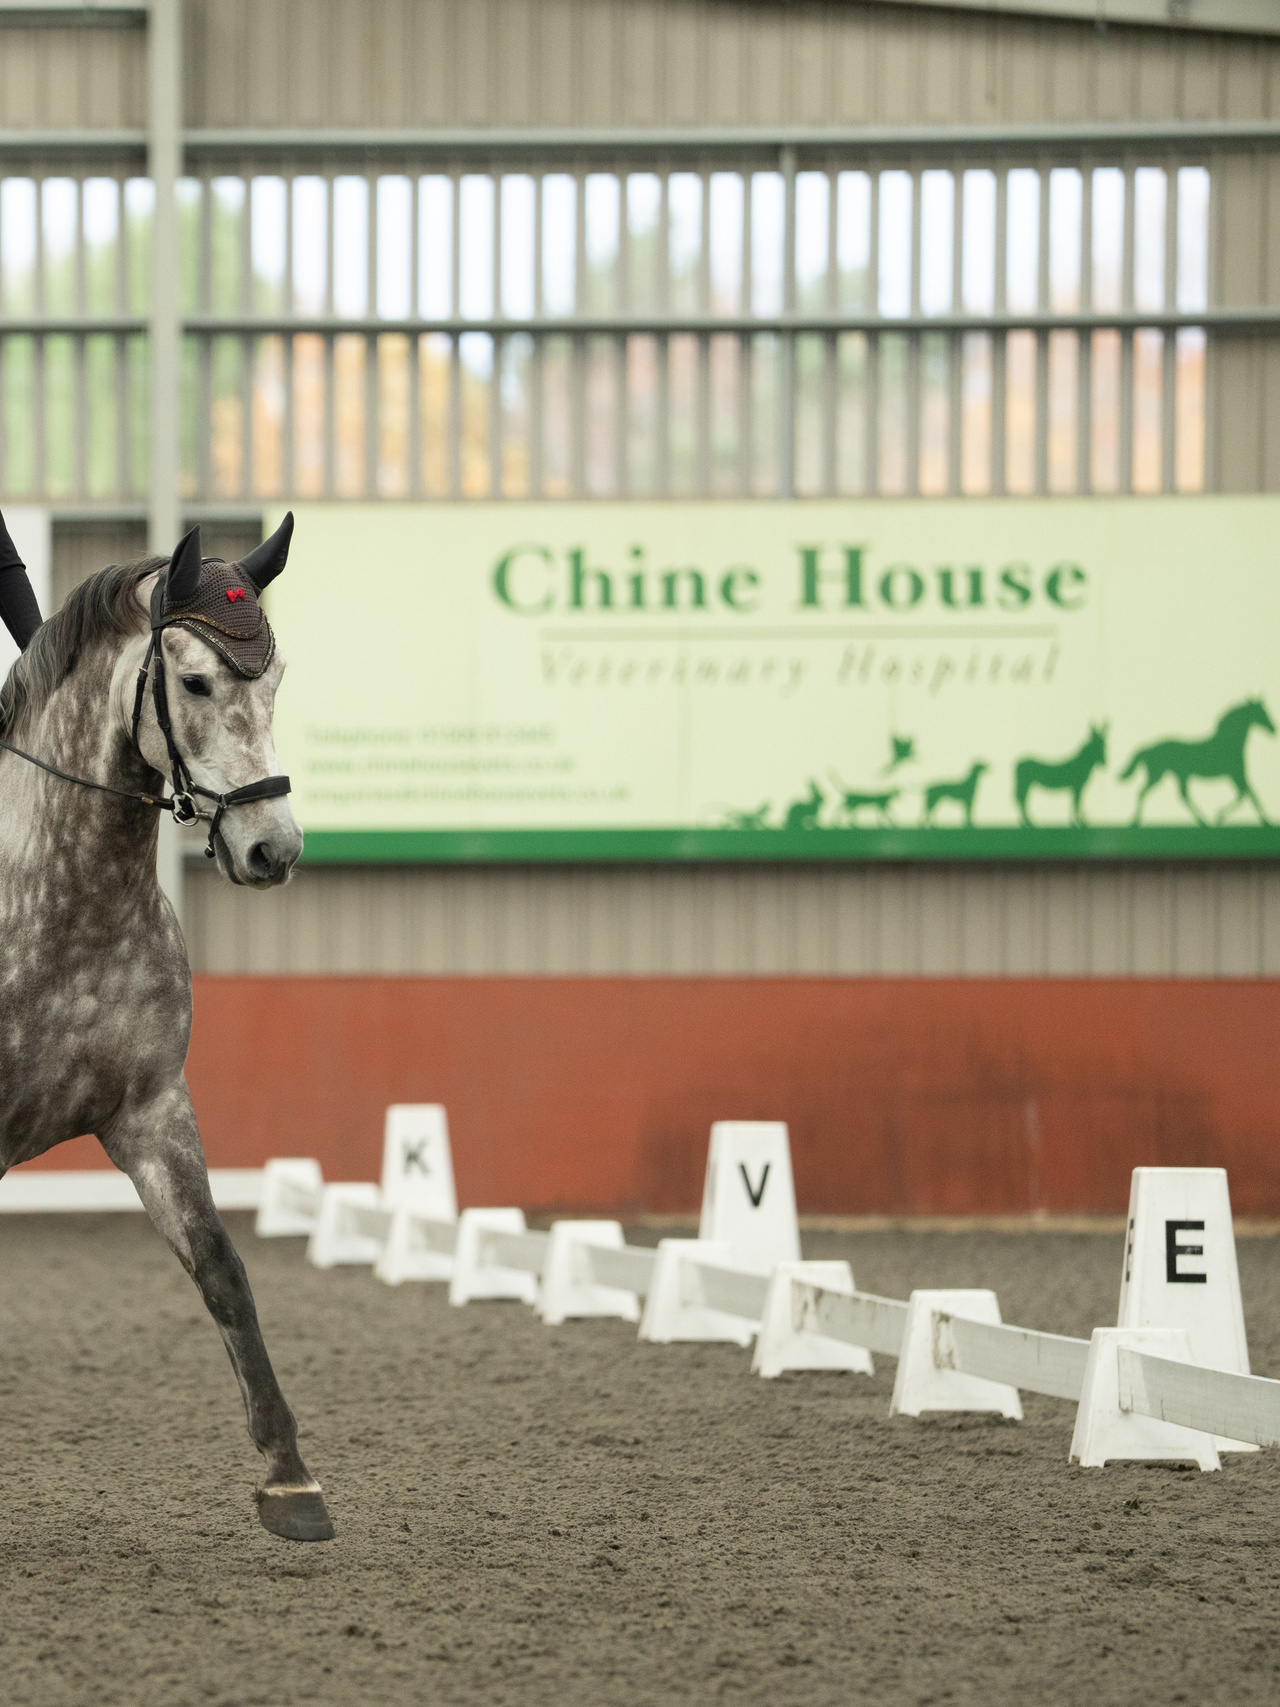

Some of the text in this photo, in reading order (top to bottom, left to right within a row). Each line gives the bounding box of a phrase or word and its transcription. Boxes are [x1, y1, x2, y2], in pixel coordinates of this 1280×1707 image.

[490, 540, 1090, 616] Chine House
[540, 640, 1061, 699] Veterinary Hospital
[402, 1136, 433, 1179] K
[738, 1161, 771, 1208] V
[1165, 1220, 1207, 1283] E
